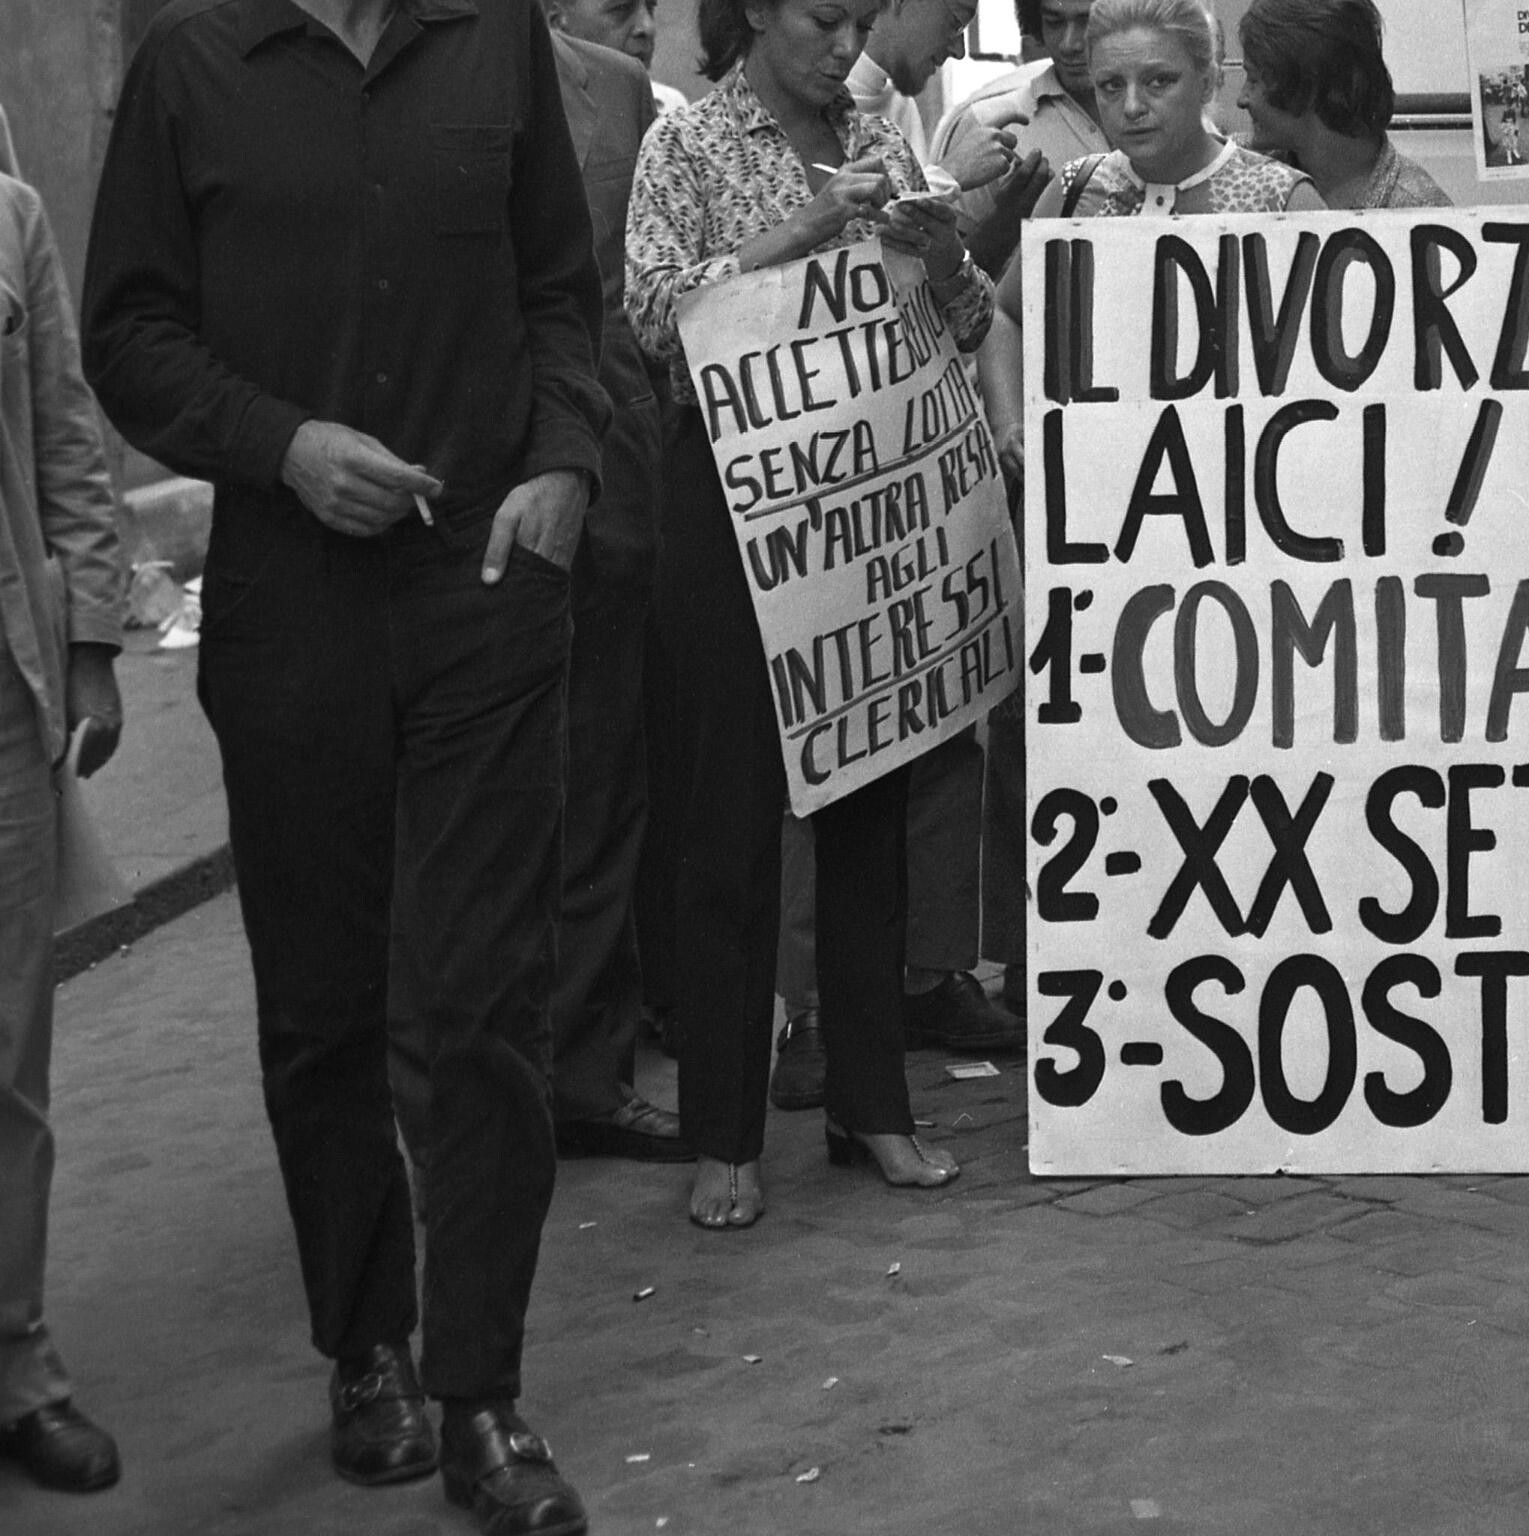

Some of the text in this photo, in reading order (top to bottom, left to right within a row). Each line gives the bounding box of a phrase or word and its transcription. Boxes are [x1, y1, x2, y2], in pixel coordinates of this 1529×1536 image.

[1043, 238, 1120, 405] IL
[724, 357, 979, 514] SENZA LOTTA
[746, 420, 999, 592] UN'ALTRA RESA
[770, 536, 1009, 730] INTERESSI
[865, 525, 949, 605] AGLI
[800, 614, 1015, 786] CLERICALI
[1145, 769, 1336, 939] XX
